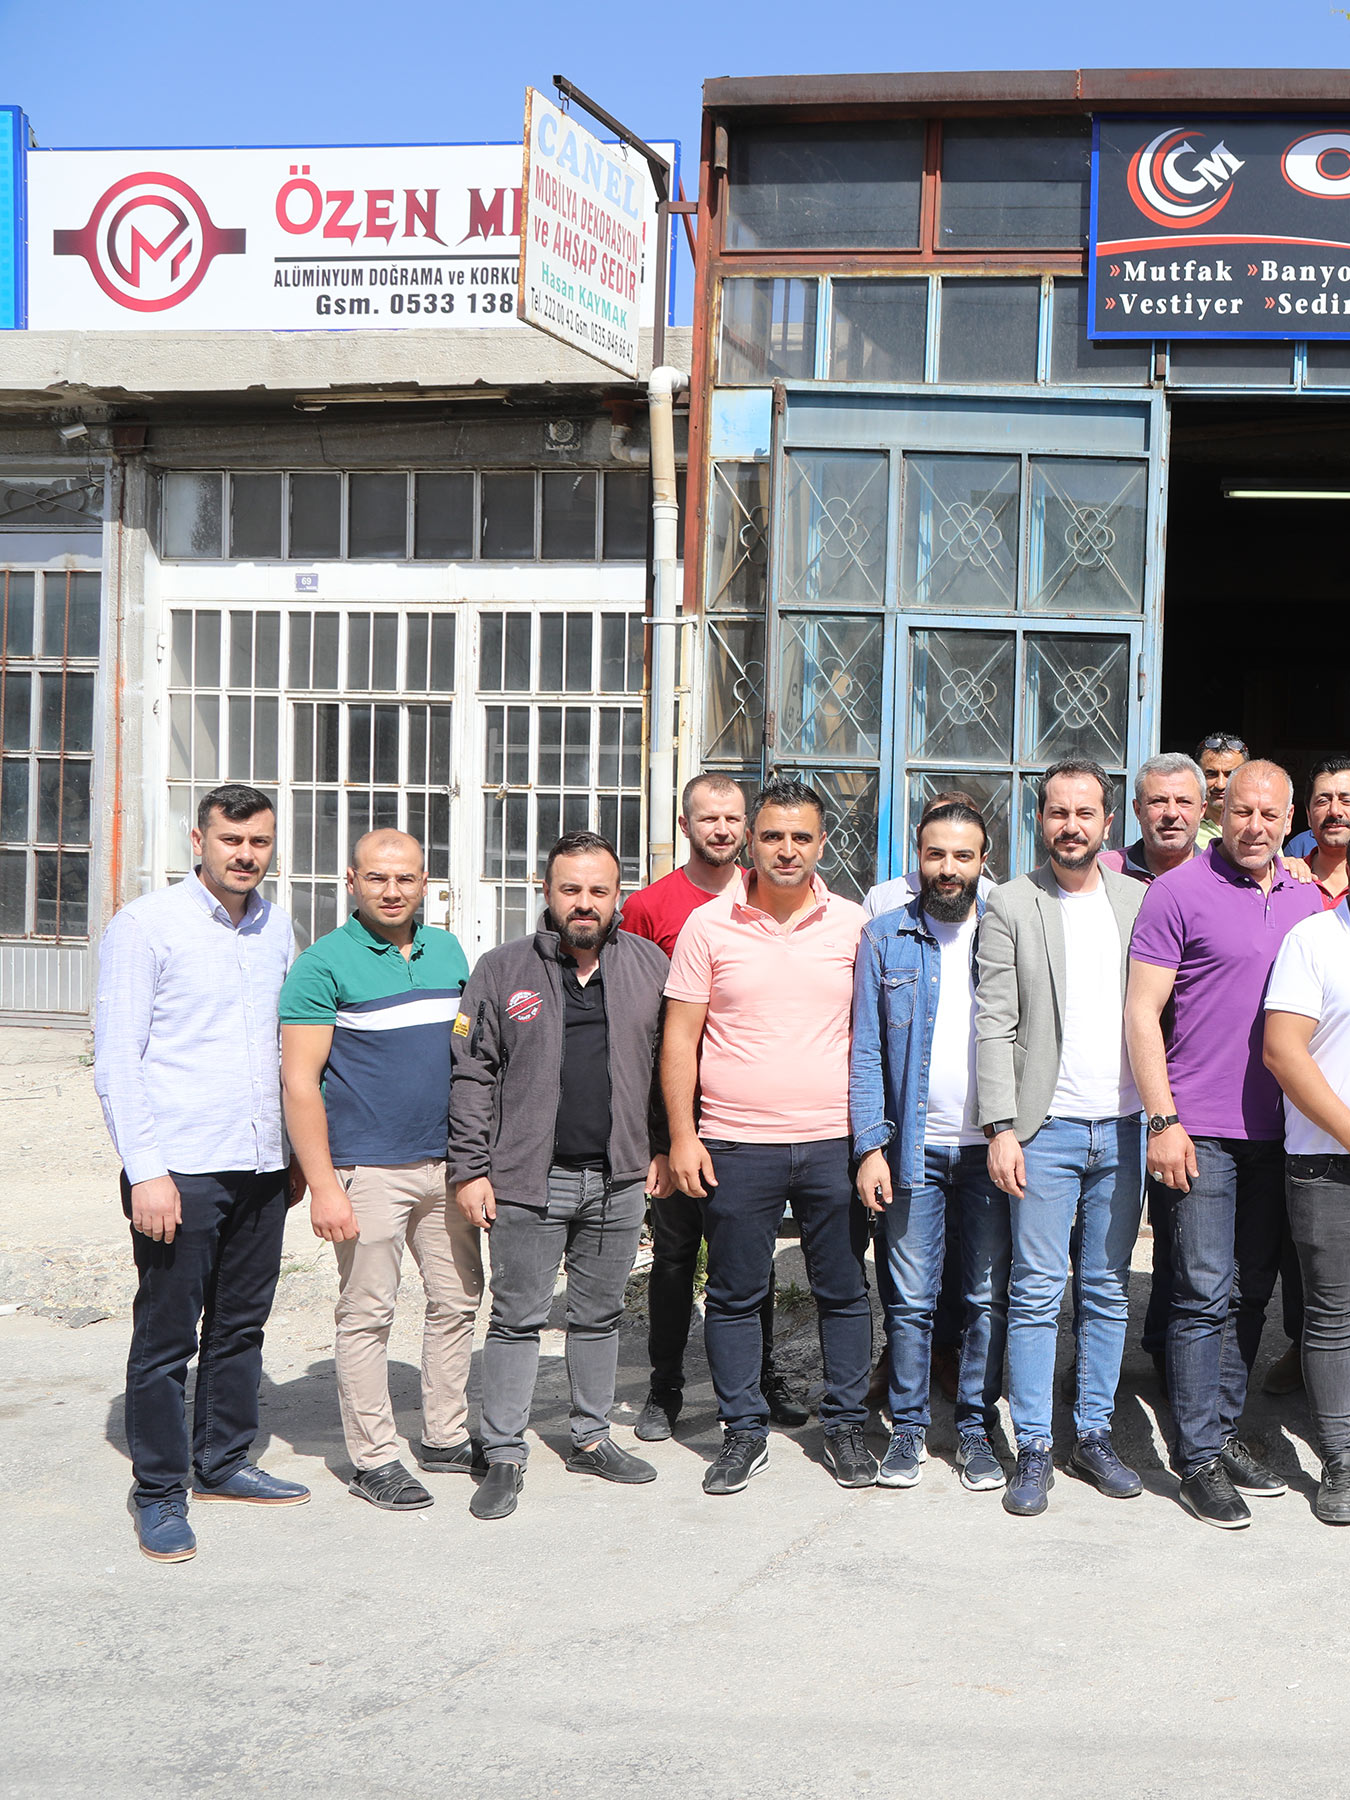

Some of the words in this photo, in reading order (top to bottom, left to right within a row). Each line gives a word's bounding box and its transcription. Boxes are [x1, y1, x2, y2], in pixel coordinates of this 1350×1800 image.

[537, 113, 638, 220] CANEL
[275, 165, 449, 247] ÖZEN
[535, 164, 578, 226] MOBİLYA
[580, 196, 638, 266] DEKORASYON
[273, 265, 364, 287] ALÜMİNYUM
[369, 264, 443, 286] DOĞRAMA
[448, 270, 465, 285] ve
[534, 215, 549, 247] ve
[552, 221, 598, 276] AHŞAP
[600, 252, 637, 303] SEDİR
[1123, 260, 1233, 282] Mutfak
[316, 294, 379, 315] Gsm.
[390, 293, 455, 314] 0533
[467, 293, 513, 314] 138
[541, 261, 575, 302] Hasan
[578, 284, 627, 330] KAYMAK
[1119, 293, 1243, 320] Vestiyer
[301, 577, 312, 586] 69
